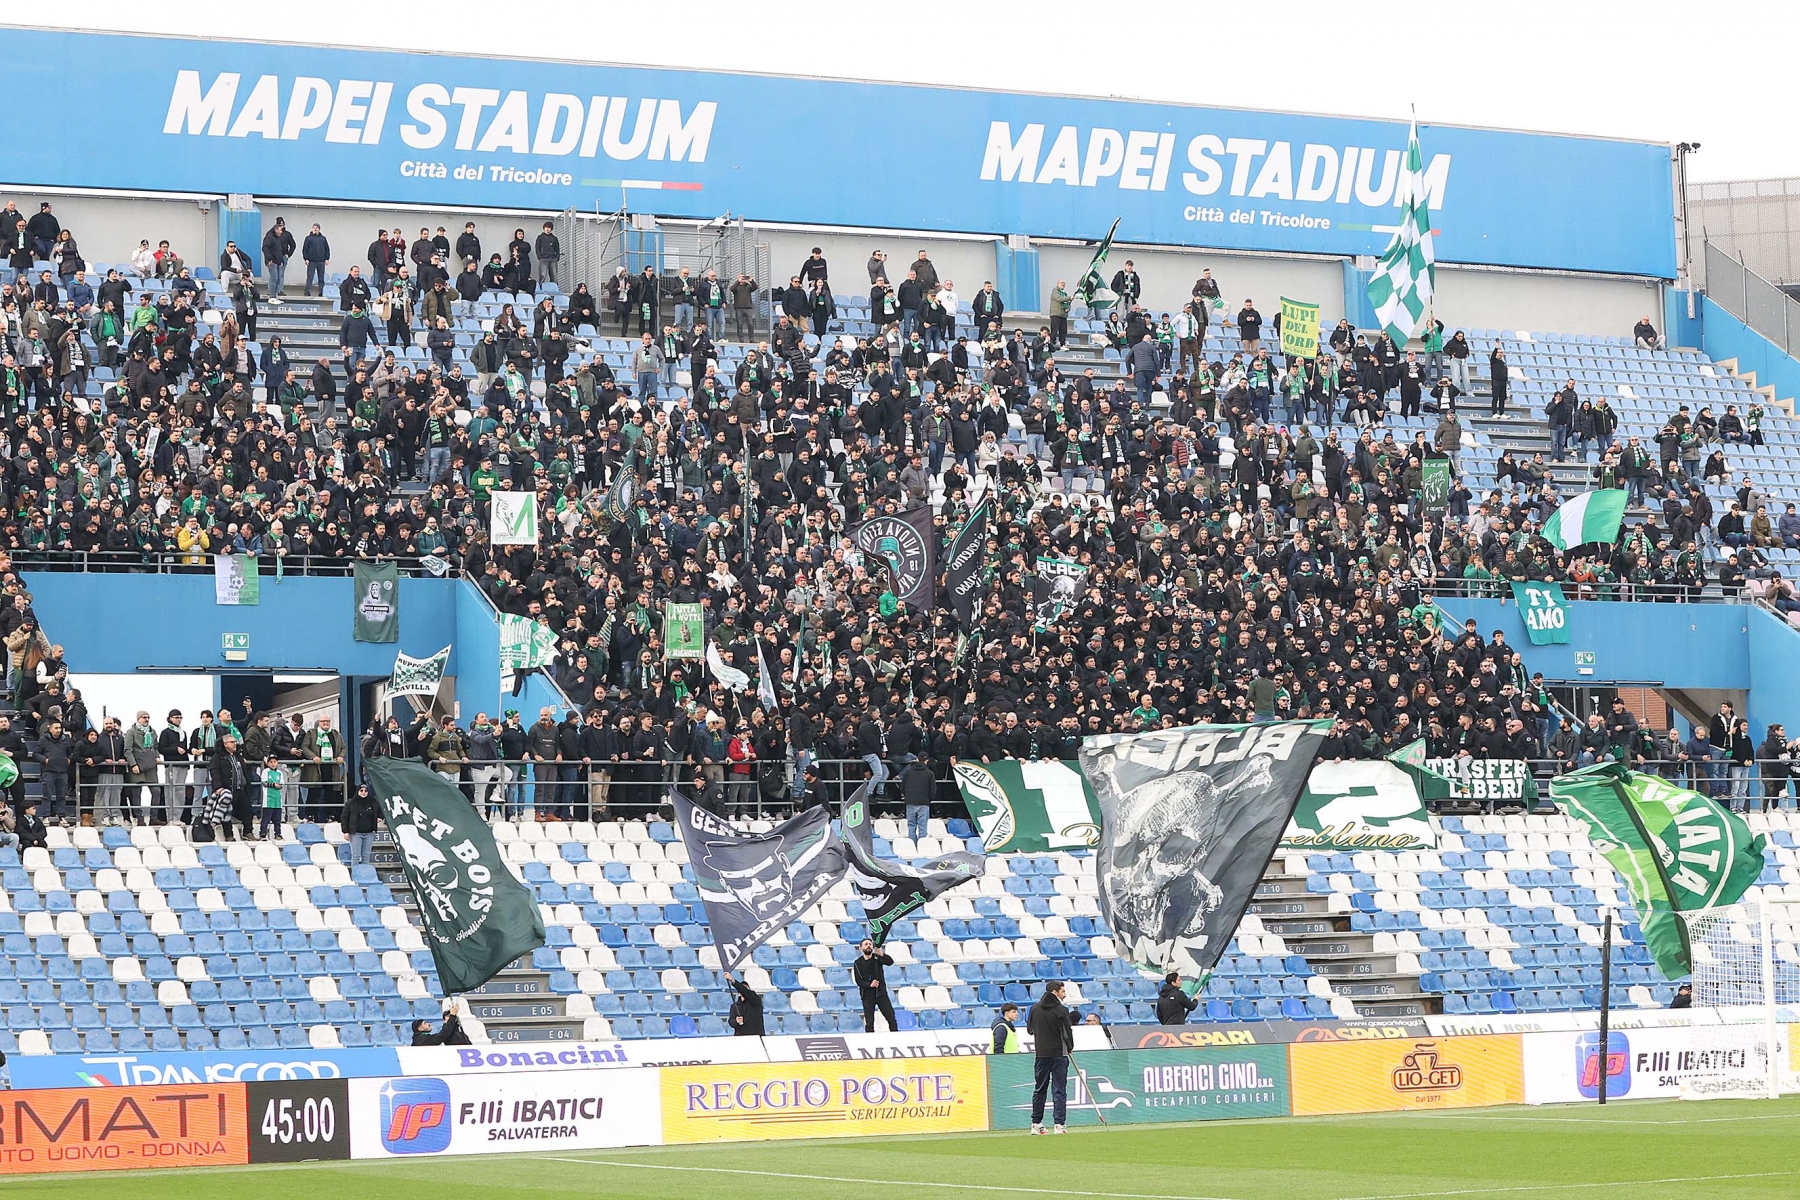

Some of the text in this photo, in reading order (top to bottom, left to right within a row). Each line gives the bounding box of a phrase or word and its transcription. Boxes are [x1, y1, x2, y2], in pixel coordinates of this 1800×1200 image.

[162, 69, 718, 163] MAPEI STADIUM
[400, 159, 573, 186] Città del Tricolore
[979, 121, 1451, 210] MAPEI STADIUM
[1184, 206, 1330, 229] Città del Tricolore
[1282, 304, 1316, 322] LUPI
[1285, 320, 1308, 334] DEL
[1283, 332, 1315, 348] ORD
[1525, 588, 1556, 608] TI
[673, 605, 697, 613] TUTTA
[1527, 607, 1565, 630] AMO
[389, 684, 431, 695] TAVILLA
[1282, 822, 1418, 848] ellino
[383, 854, 394, 862] 12
[1270, 885, 1280, 893] 10
[1307, 924, 1324, 932] F 08
[1330, 944, 1346, 952] F 07
[1312, 966, 1329, 974] E 06
[515, 984, 536, 992] E 06
[1336, 986, 1352, 994] E 05
[1374, 986, 1378, 994] F
[482, 1008, 502, 1016] C 05
[532, 1006, 552, 1015] E 05
[1364, 1008, 1375, 1016] 04
[1406, 1007, 1417, 1015] 04
[549, 1030, 570, 1039] E 04
[1503, 1022, 1544, 1033] NOVA
[498, 1032, 520, 1040] C 04
[456, 1044, 628, 1068] Bonacini
[858, 1045, 931, 1060] MAIL
[1678, 1048, 1745, 1071] IBATICI
[1143, 1064, 1214, 1094] ALBERICI
[1218, 1062, 1257, 1090] GINO
[685, 1074, 955, 1112] REGGIO POSTE
[1146, 1092, 1275, 1108] RECAPITO CORRIERI
[512, 1098, 604, 1123] IBATICI
[850, 1105, 952, 1121] SERVIZI POSTALI
[0, 1093, 226, 1146] MATI
[261, 1097, 336, 1145] 45:00
[387, 1103, 446, 1142] IP
[488, 1125, 578, 1142] SALVATERRA
[48, 1145, 120, 1160] UOMO
[142, 1140, 227, 1157] DONNA
